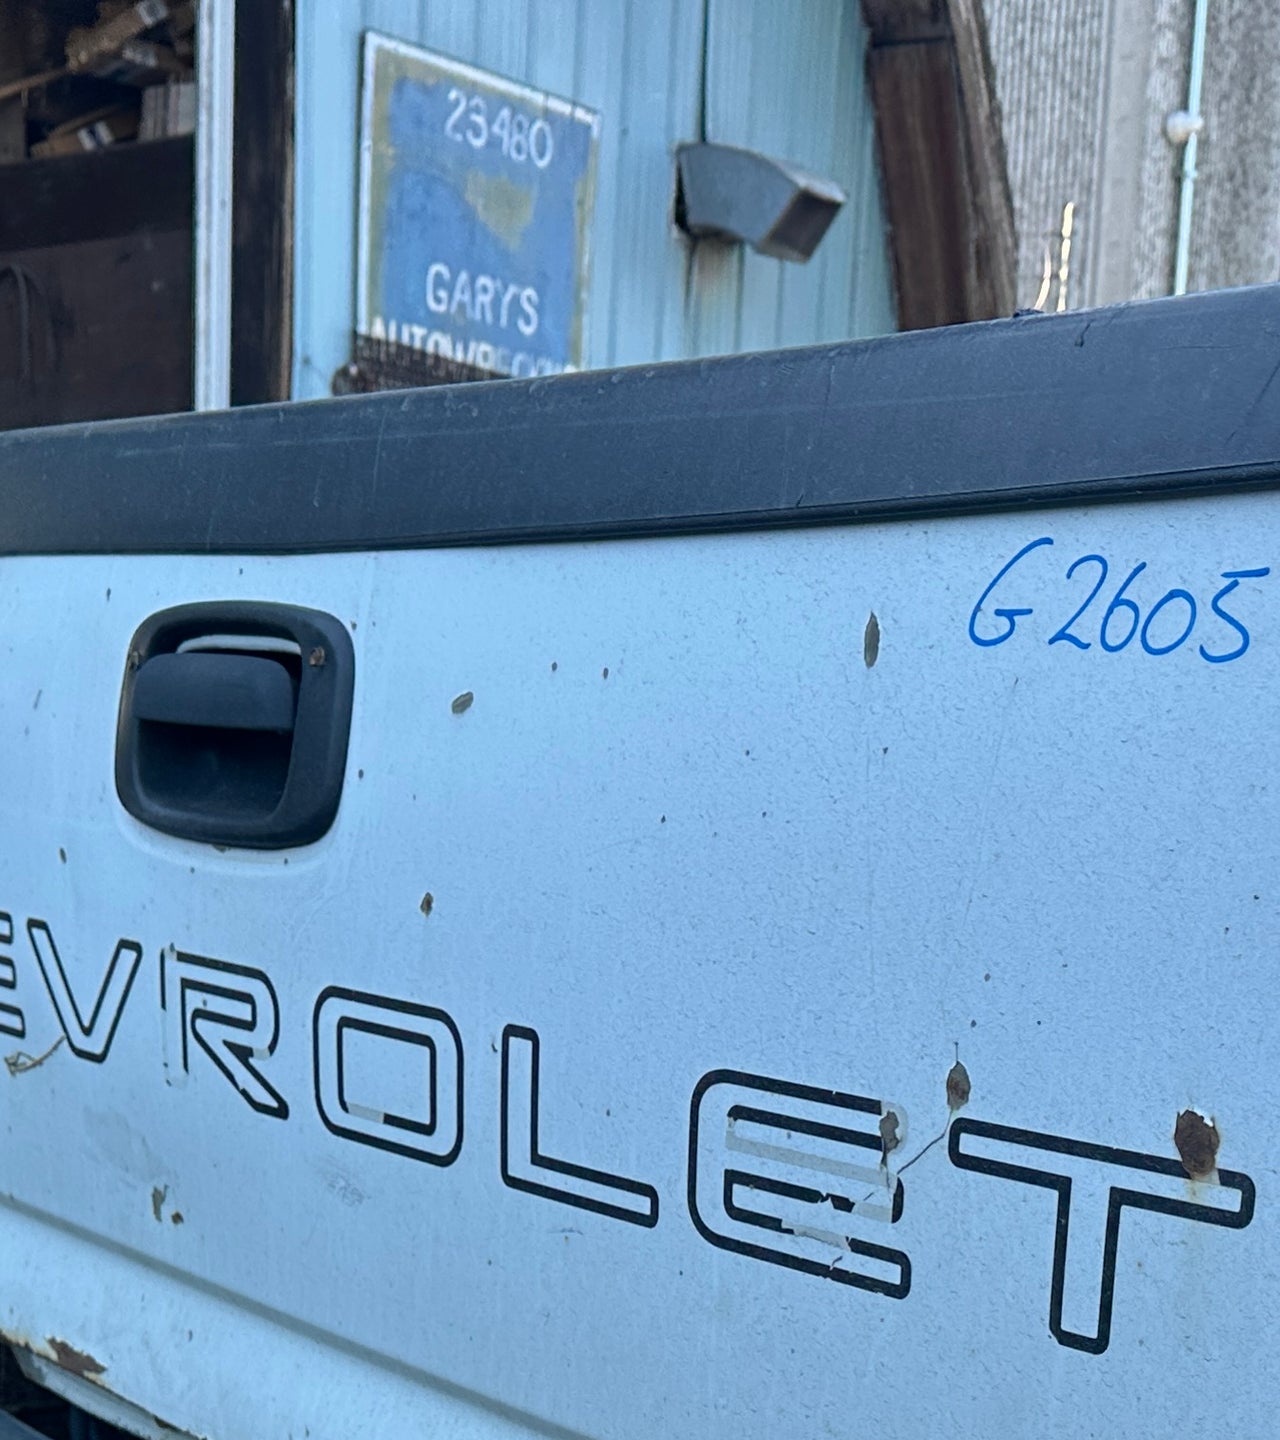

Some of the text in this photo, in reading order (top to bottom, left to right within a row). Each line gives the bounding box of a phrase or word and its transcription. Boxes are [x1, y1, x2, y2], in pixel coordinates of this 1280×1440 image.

[444, 87, 553, 169] 23480
[425, 262, 540, 336] GARYS
[969, 536, 1270, 663] G2605
